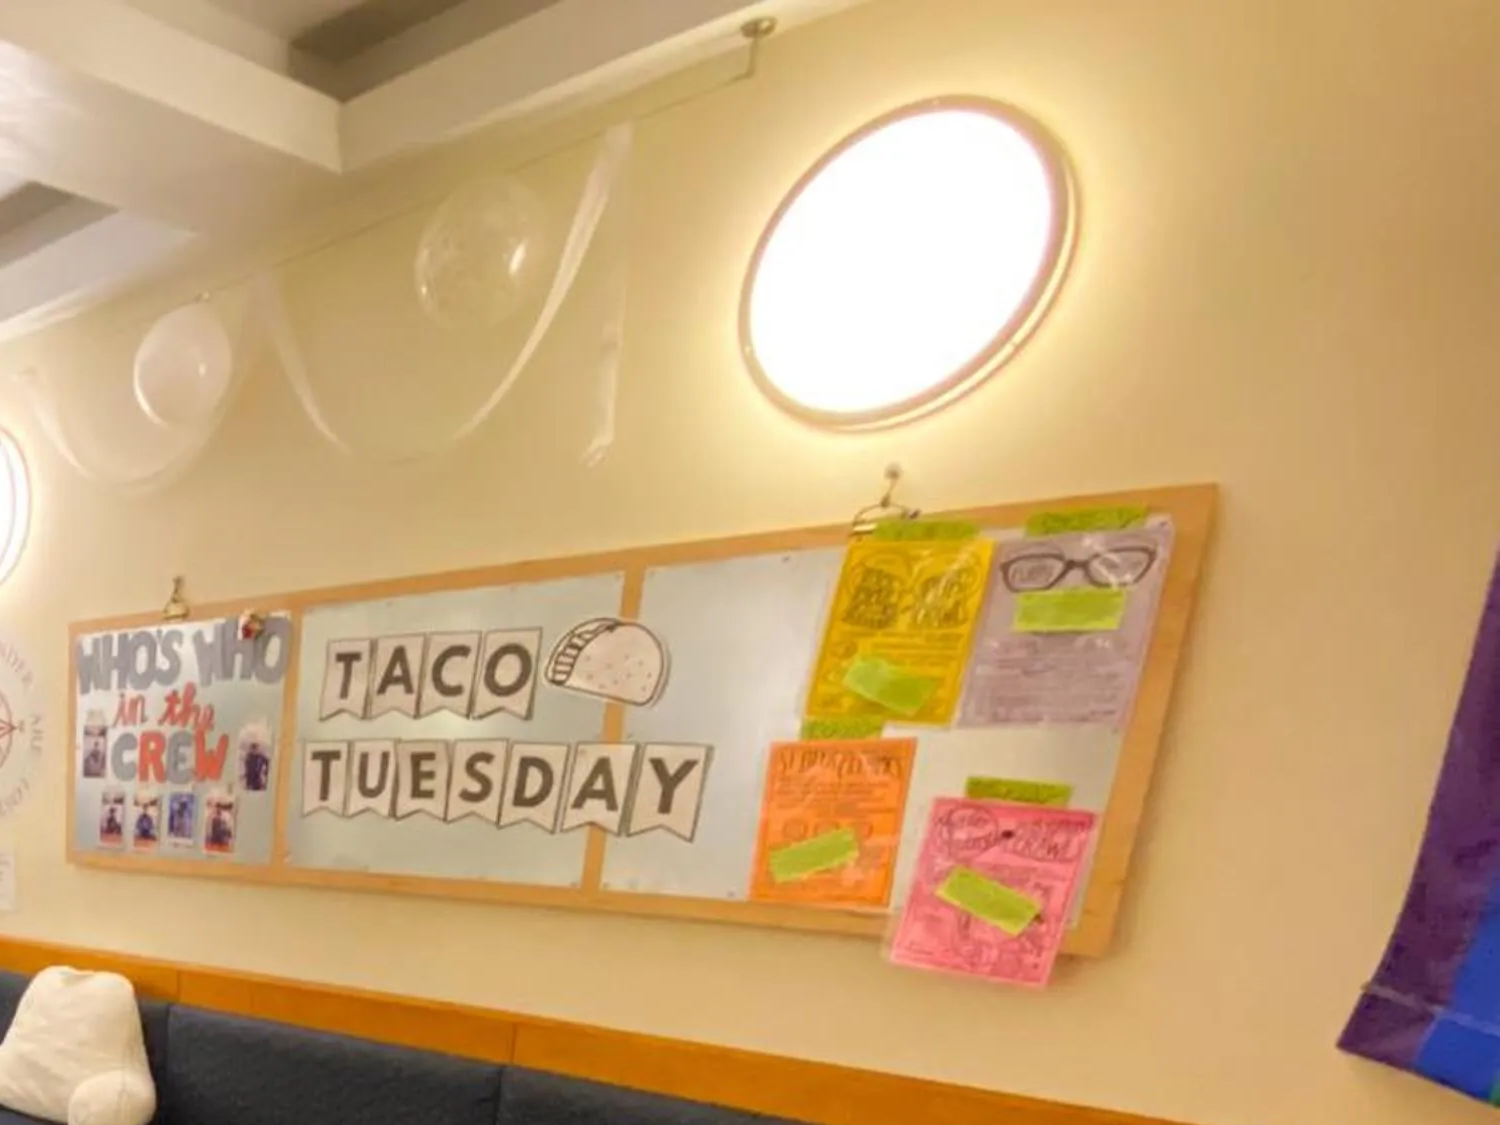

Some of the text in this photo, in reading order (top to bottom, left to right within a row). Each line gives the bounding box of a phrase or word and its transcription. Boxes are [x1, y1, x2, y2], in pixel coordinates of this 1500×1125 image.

[193, 615, 293, 687] WHO
[335, 643, 533, 699] TACO
[113, 681, 215, 731] in the
[111, 729, 229, 785] CREW
[311, 750, 699, 814] TUESDAY
